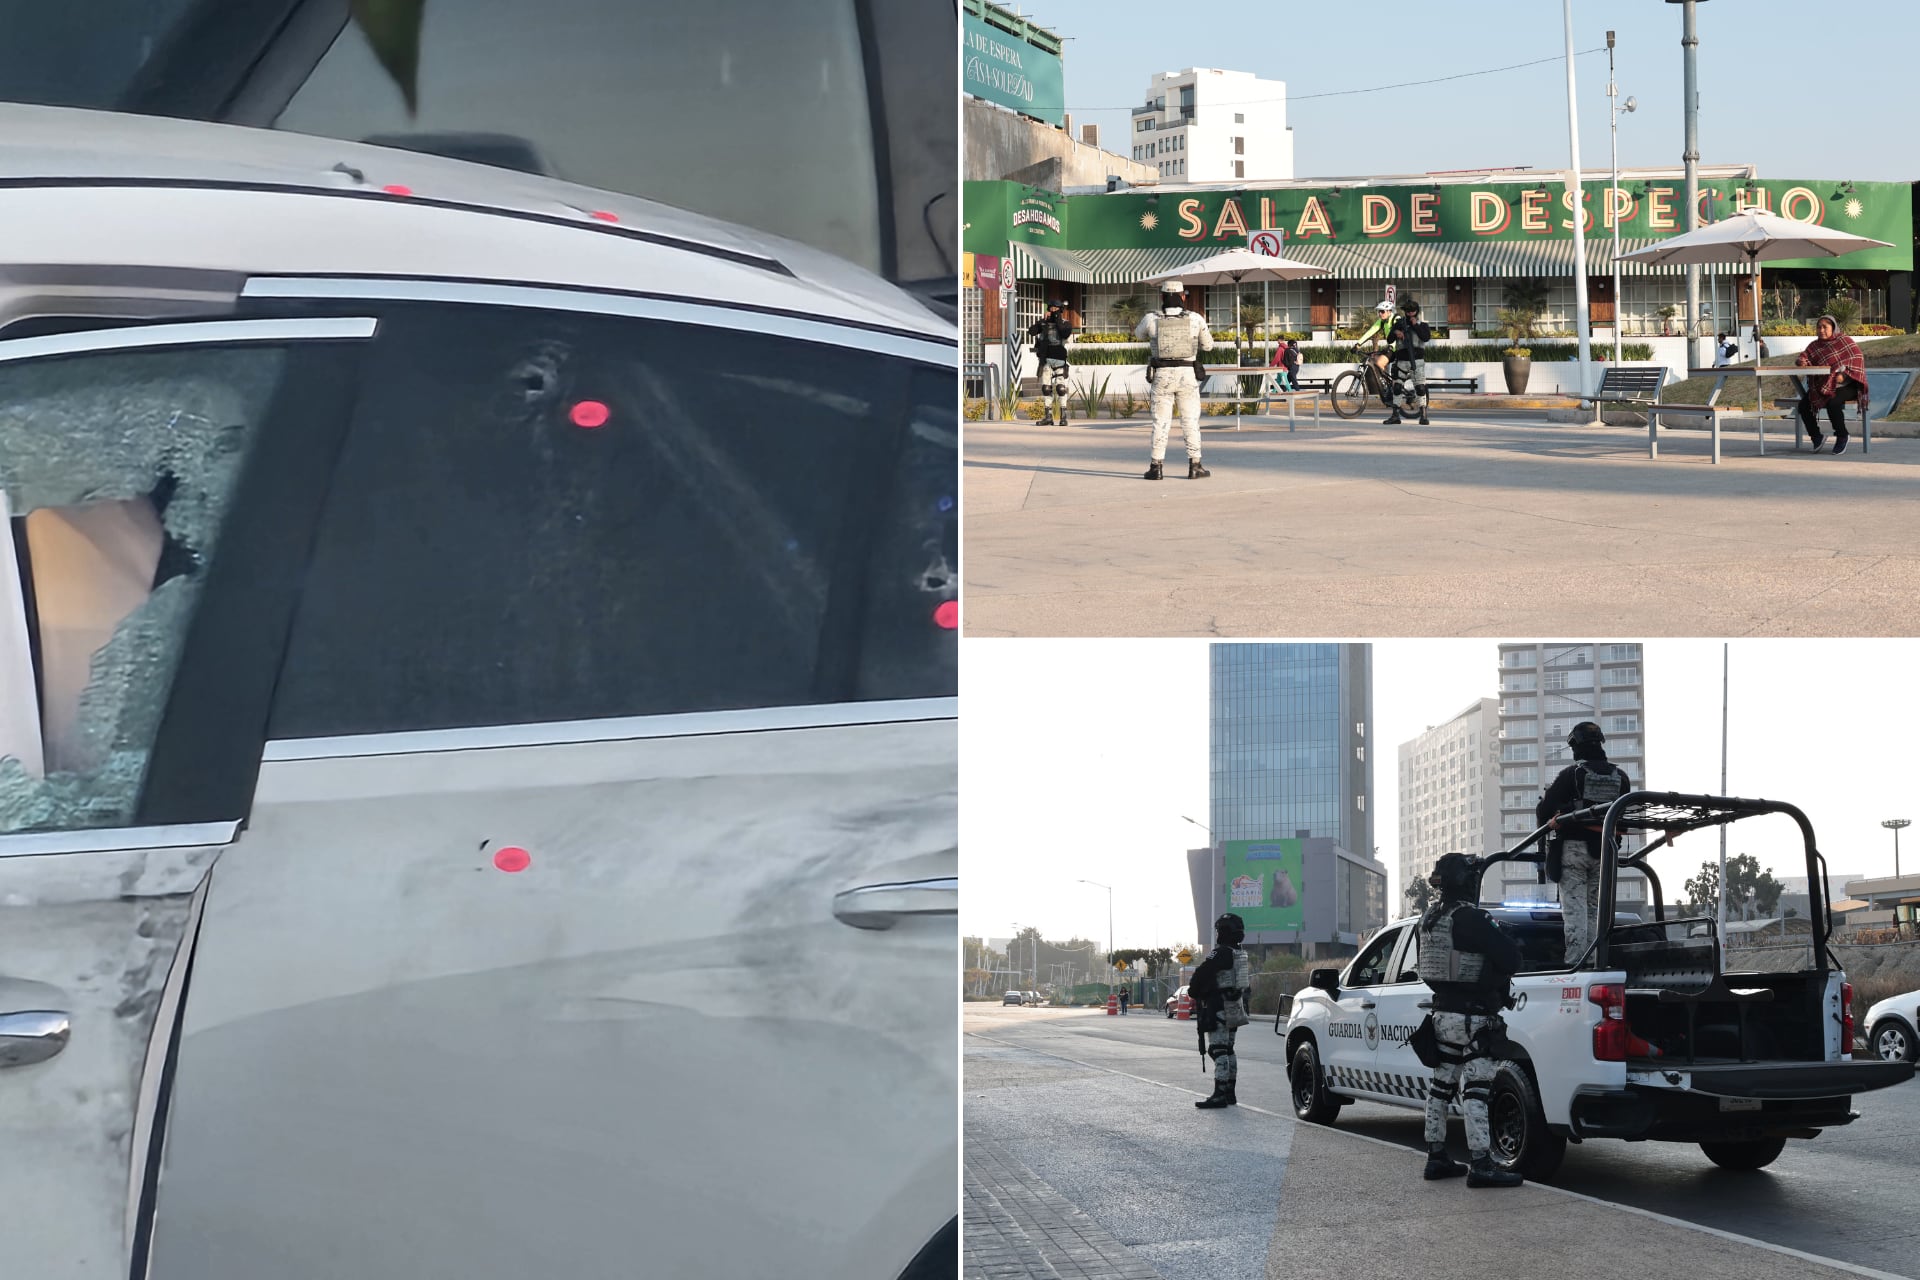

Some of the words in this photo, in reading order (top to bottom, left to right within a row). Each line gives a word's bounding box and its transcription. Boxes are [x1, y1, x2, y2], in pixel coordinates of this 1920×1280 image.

[976, 33, 988, 54] DE
[1013, 209, 1060, 234] DESAHOGAMOS
[1178, 196, 1335, 240] SALA
[1362, 193, 1441, 237] DE
[1563, 988, 1580, 998] 911
[1328, 1022, 1363, 1039] GUARDIA
